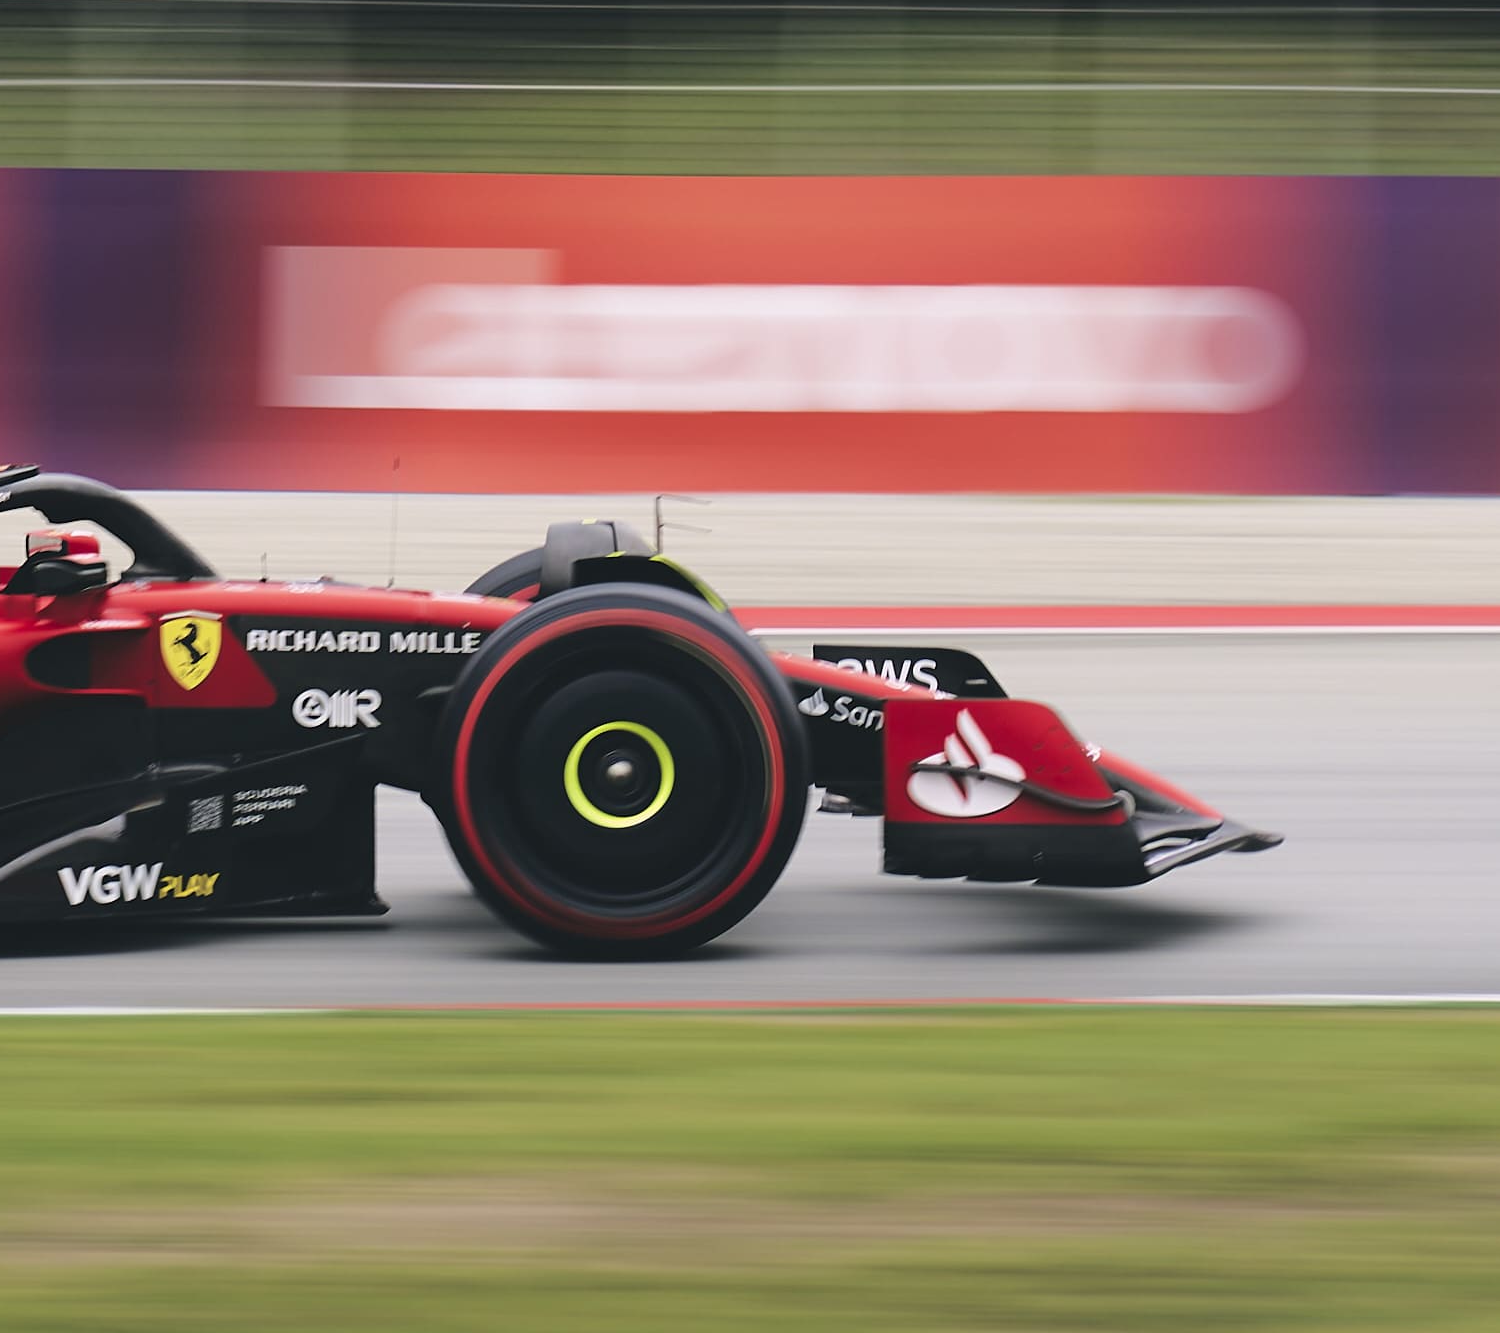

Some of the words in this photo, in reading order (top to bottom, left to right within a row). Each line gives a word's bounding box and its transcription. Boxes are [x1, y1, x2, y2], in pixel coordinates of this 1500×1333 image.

[246, 629, 381, 653] RICHARD
[389, 631, 481, 654] MILLE
[830, 695, 884, 731] San
[57, 861, 164, 906] VGW
[158, 872, 221, 900] PLAY
